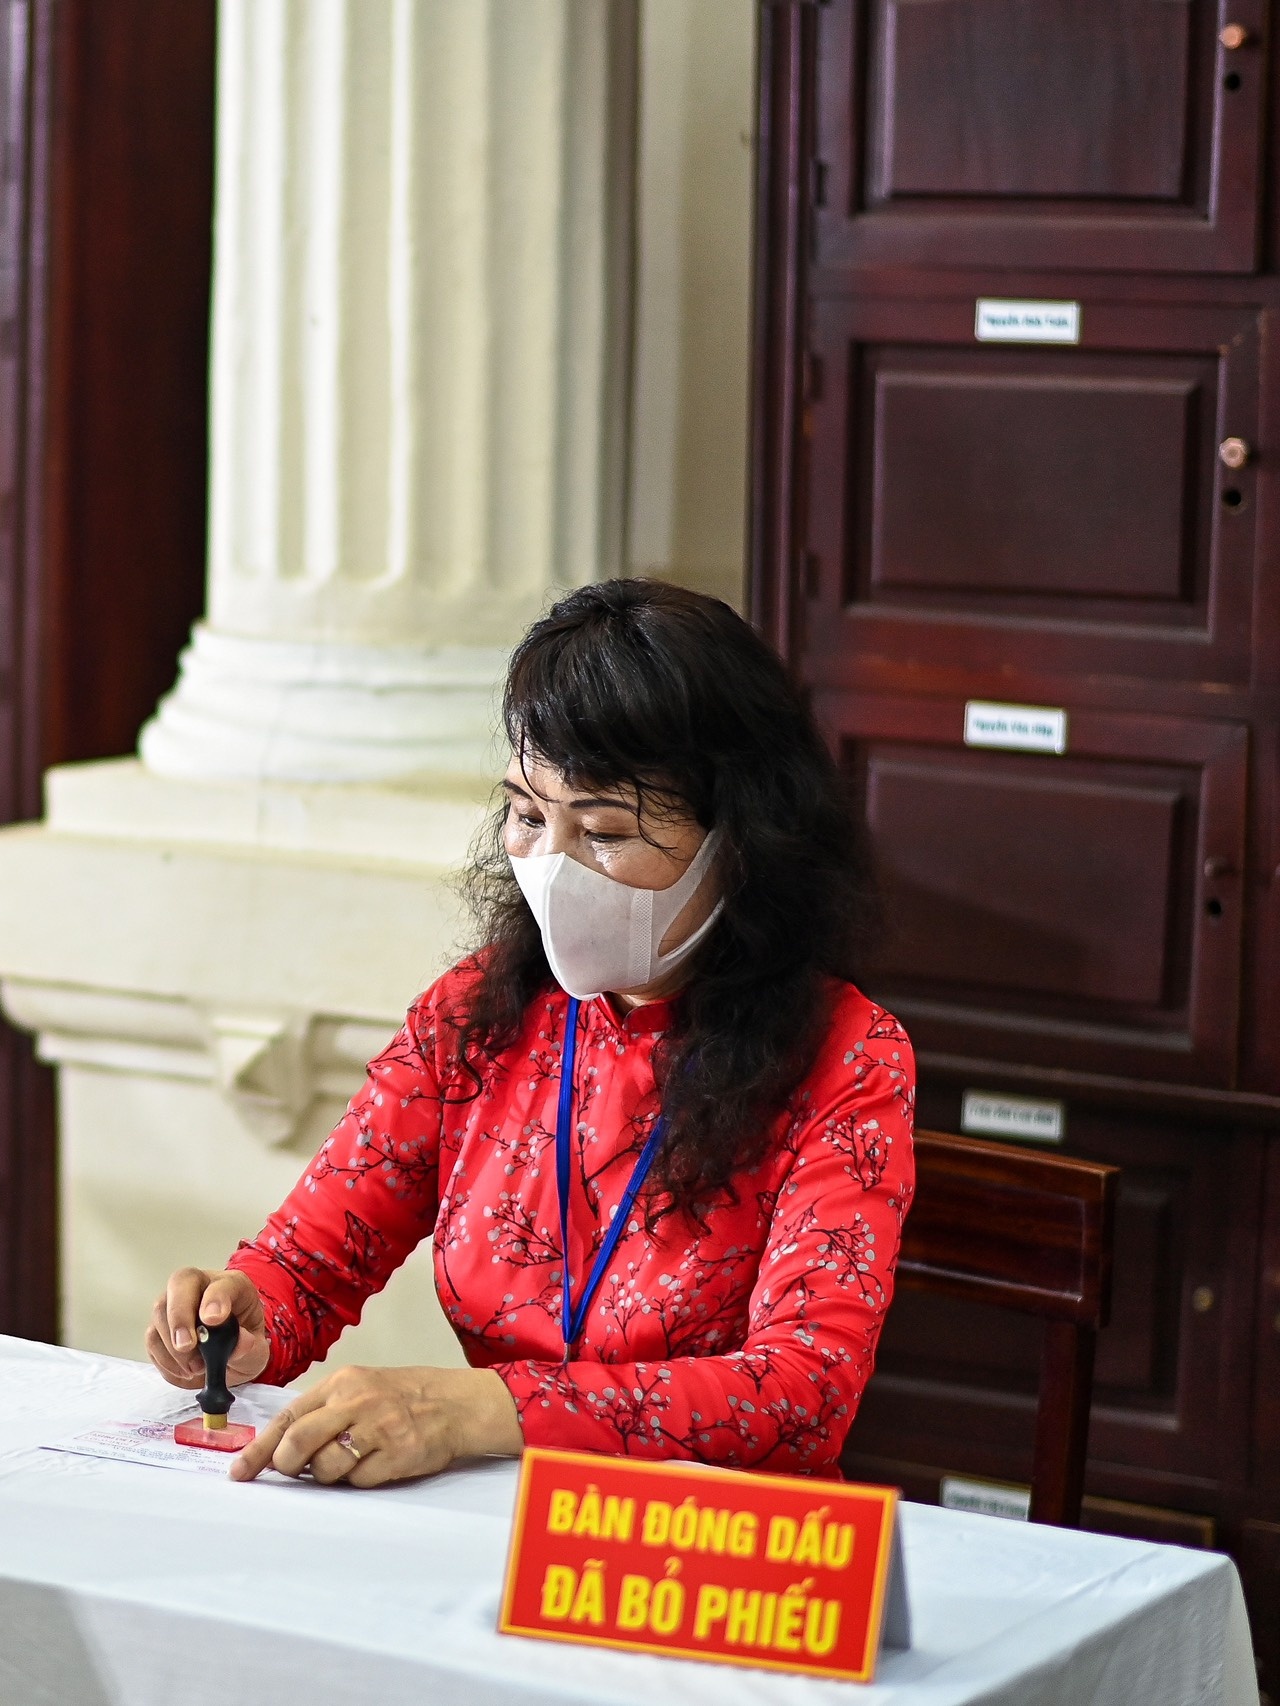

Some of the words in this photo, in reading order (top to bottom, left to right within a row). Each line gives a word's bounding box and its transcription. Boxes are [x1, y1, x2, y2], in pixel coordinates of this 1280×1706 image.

[547, 1484, 635, 1542] BÀN
[641, 1496, 758, 1557] ĐÓNG
[766, 1506, 855, 1570] DẤU
[540, 1558, 607, 1625] ĐÃ
[616, 1556, 685, 1635] BỎ
[693, 1577, 841, 1656] PHIẾU
